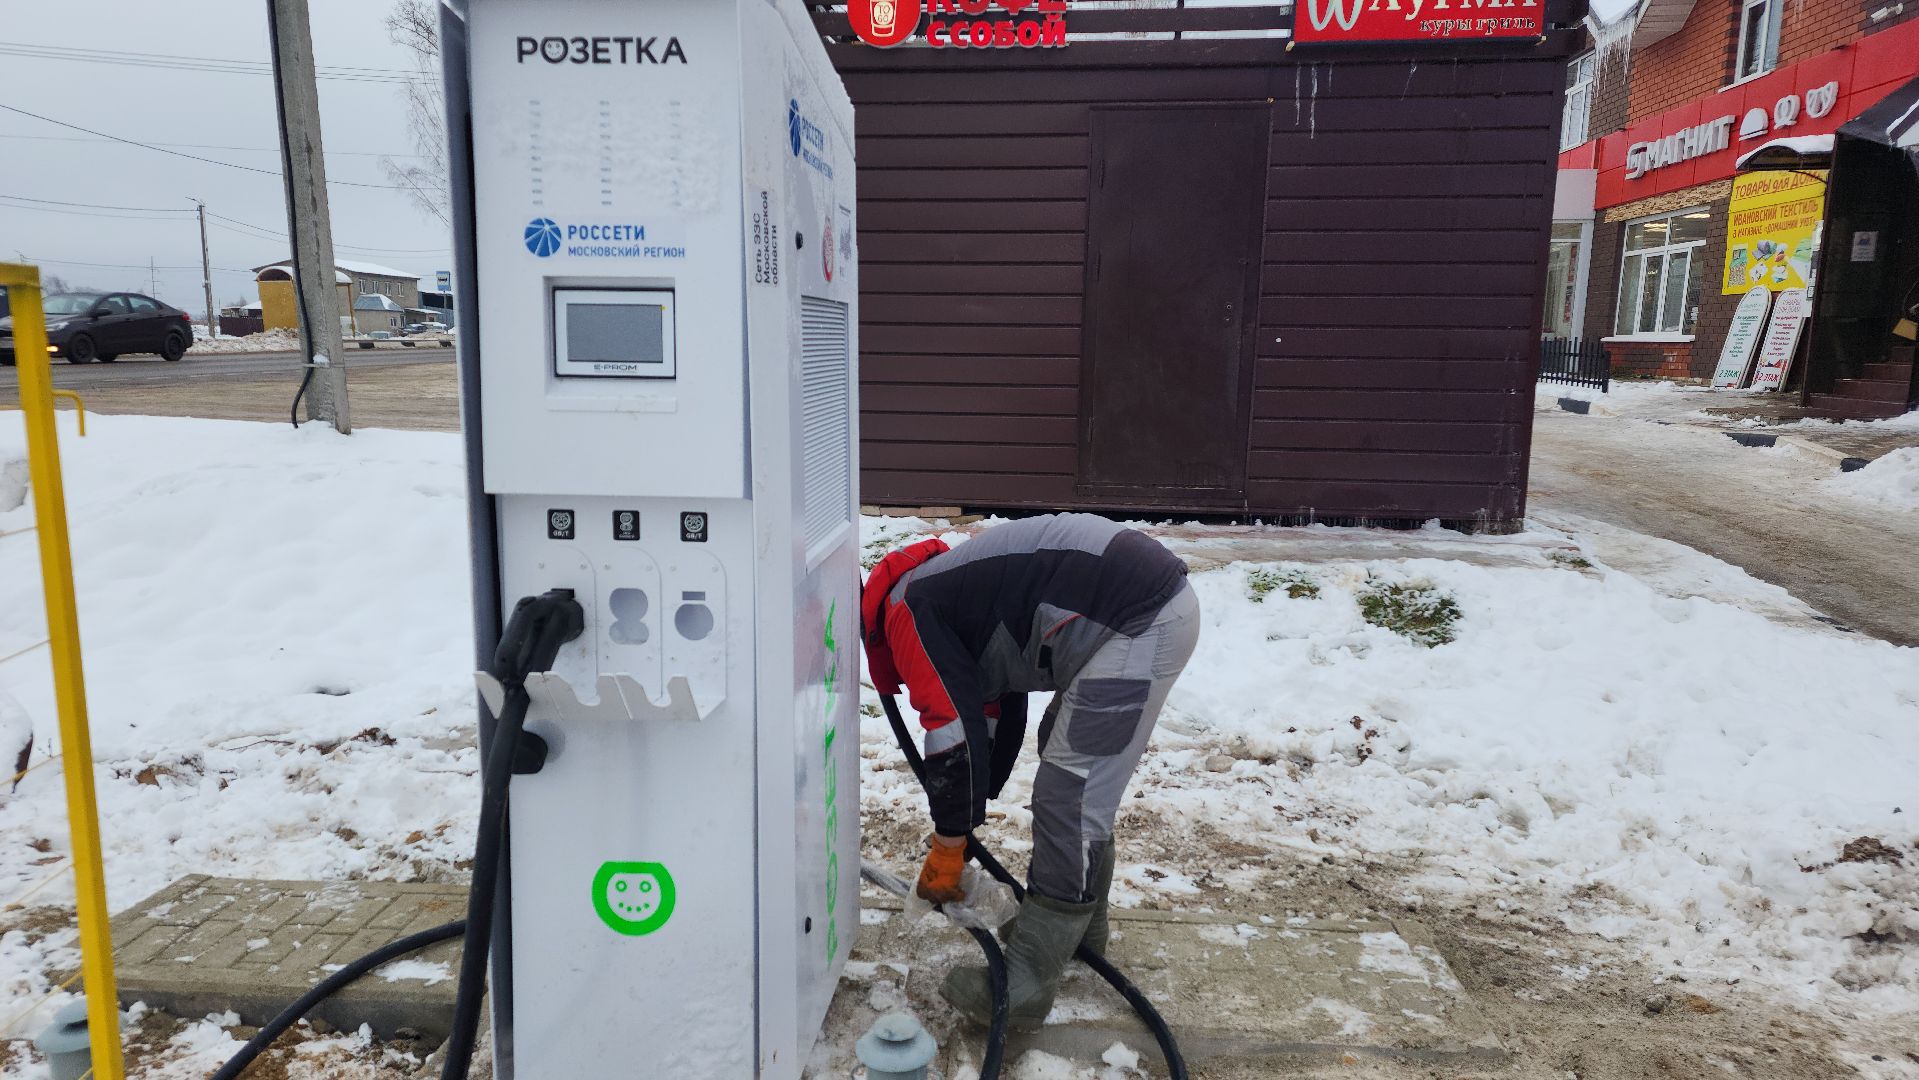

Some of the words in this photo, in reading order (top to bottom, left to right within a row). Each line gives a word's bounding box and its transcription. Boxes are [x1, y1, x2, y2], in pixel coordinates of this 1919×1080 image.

[877, 4, 891, 14] TO
[877, 14, 890, 23] GO
[1419, 17, 1472, 36] куры
[1476, 17, 1536, 35] гриль
[516, 36, 688, 65] РОЗЕТКА
[1645, 115, 1735, 171] МАГНИТ
[1735, 178, 1772, 199] ТОВАРЫ
[1773, 177, 1790, 193] для
[1780, 199, 1818, 218] ТЕКСТИЛЬ
[567, 225, 645, 240] РОССЕТИ
[753, 213, 761, 245] ЭЗС
[761, 191, 770, 284] Московской
[568, 244, 640, 257] МОСКОВСКИЙ
[643, 246, 685, 258] РЕГИОН
